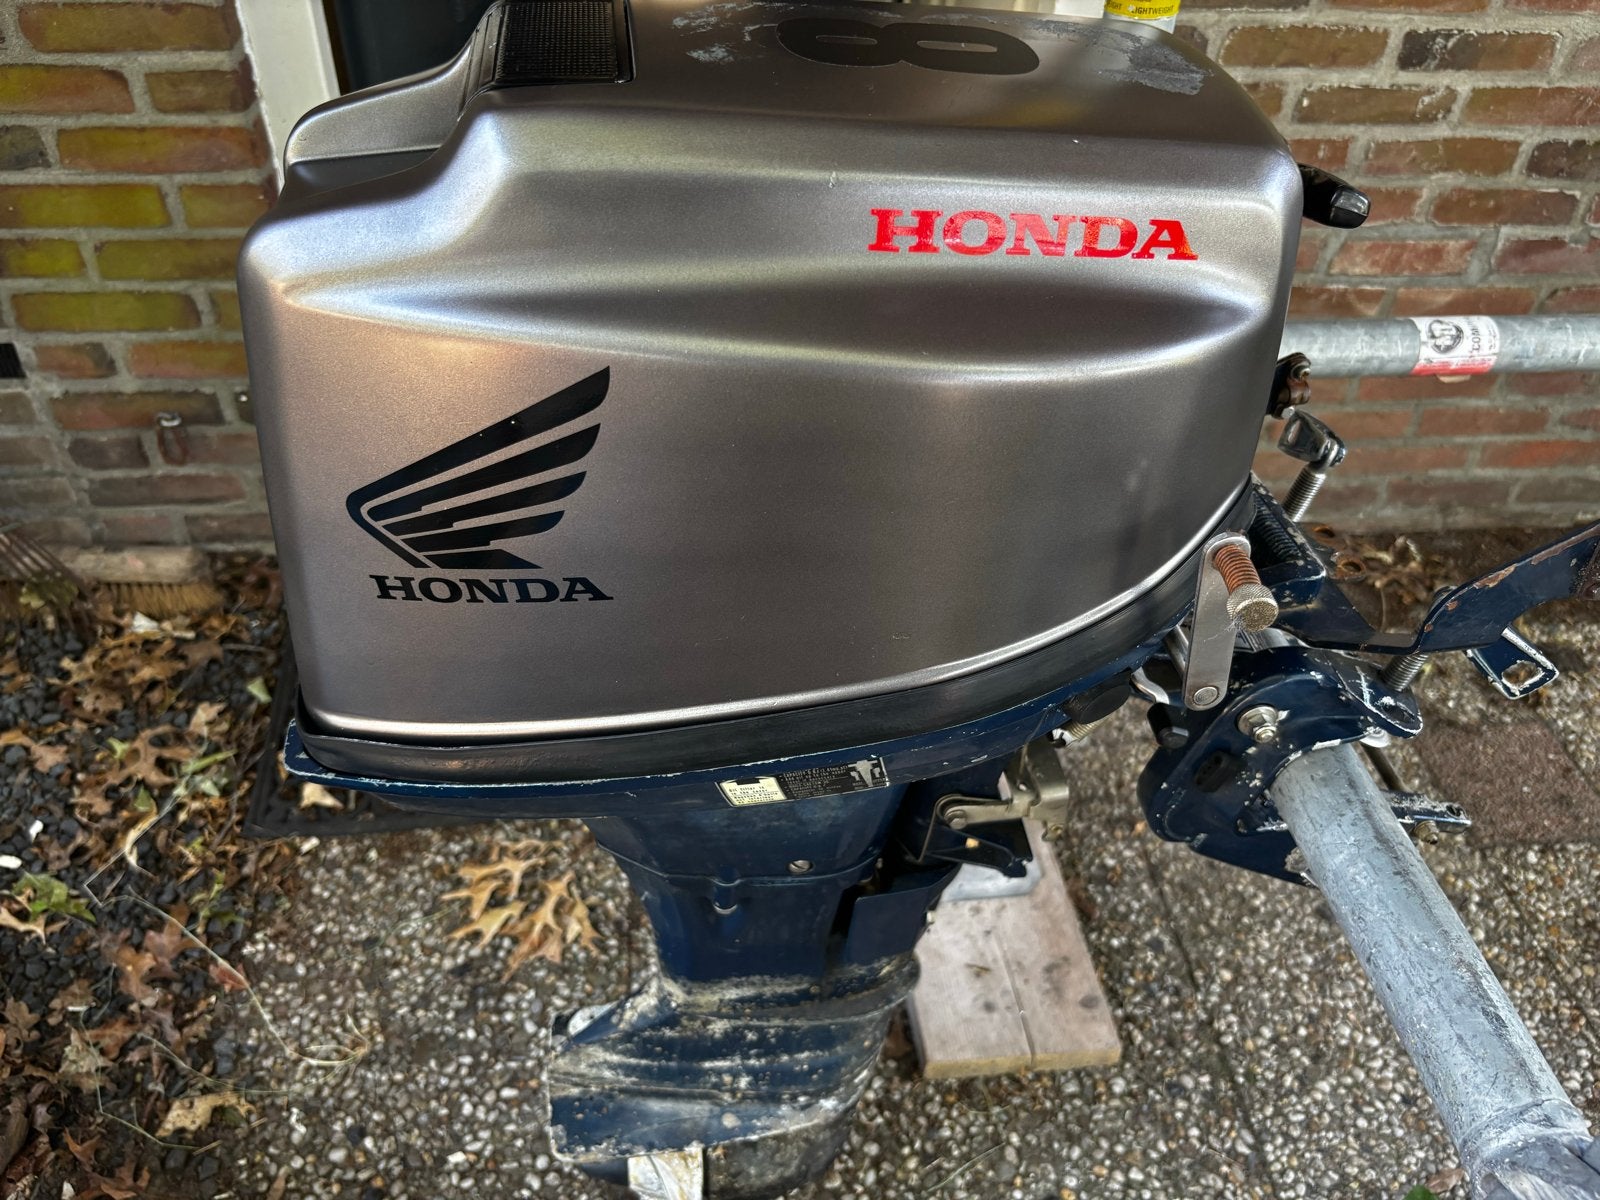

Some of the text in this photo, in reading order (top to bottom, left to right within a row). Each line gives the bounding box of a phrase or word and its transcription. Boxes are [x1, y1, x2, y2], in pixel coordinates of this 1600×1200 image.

[776, 17, 1039, 75] 8
[867, 207, 1198, 261] HONDA
[369, 574, 613, 603] HONDA
